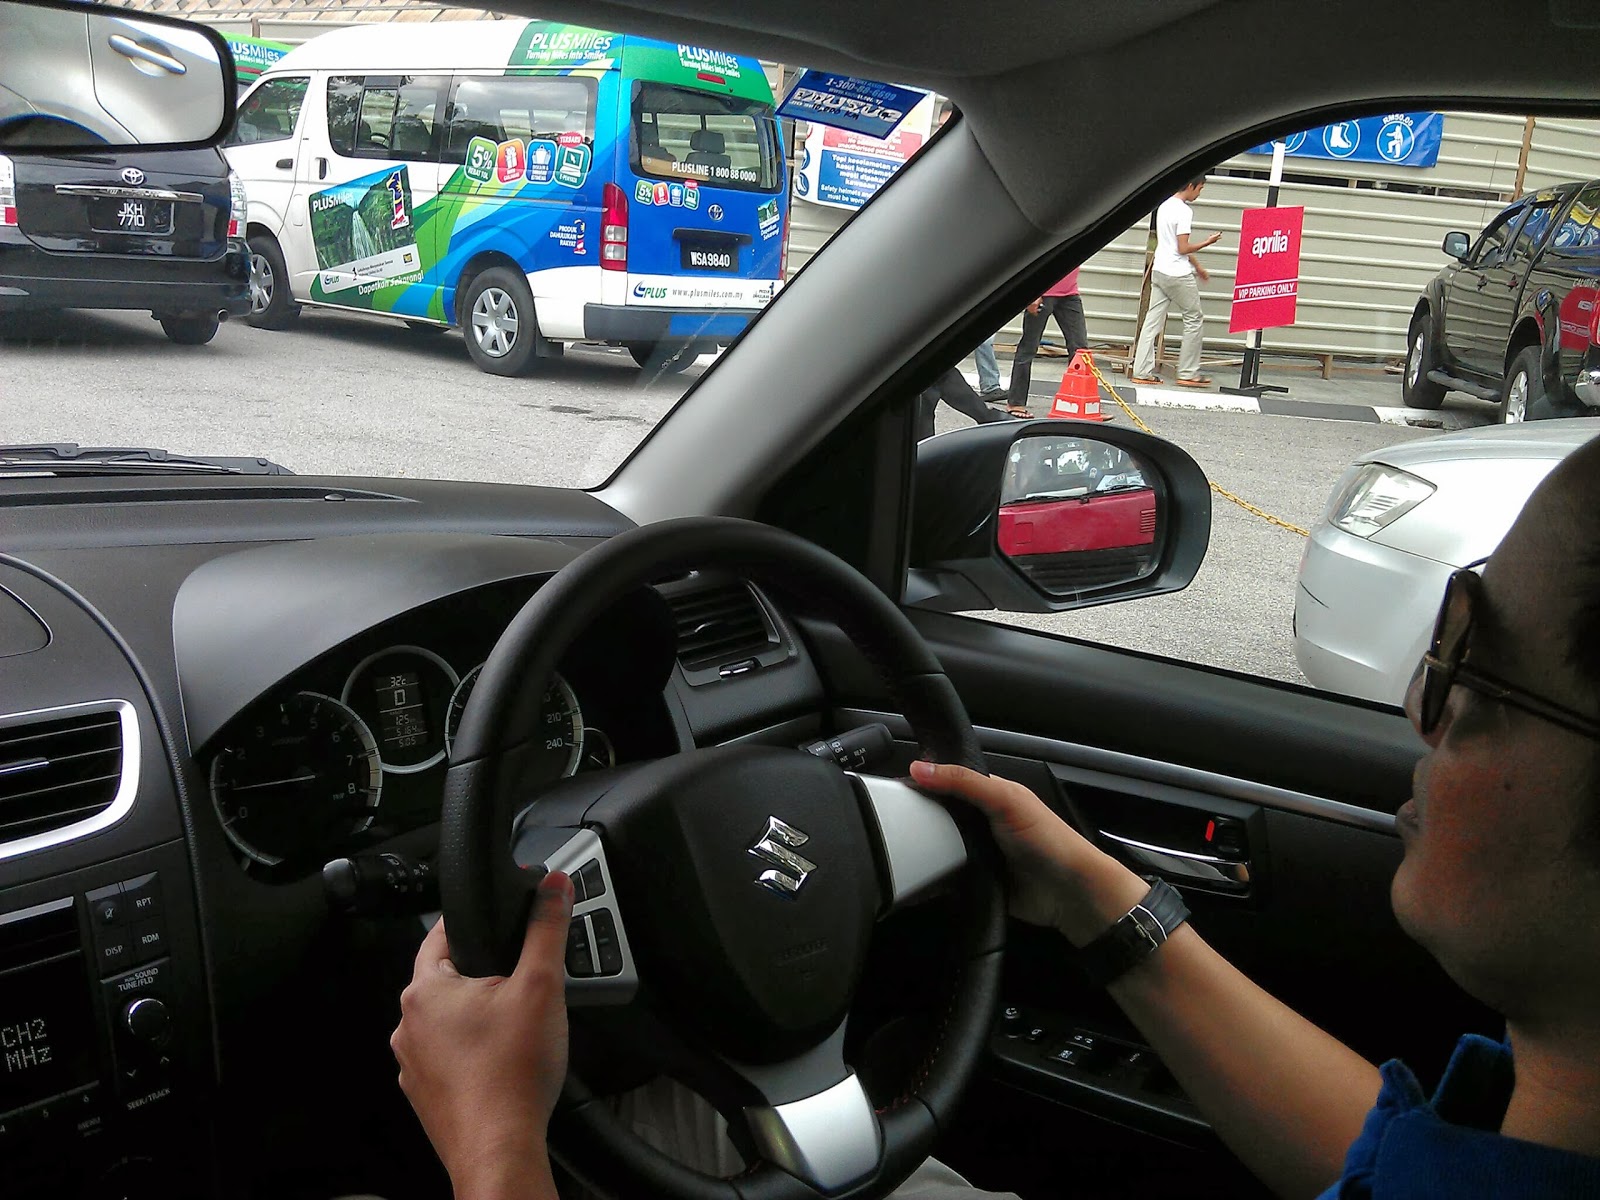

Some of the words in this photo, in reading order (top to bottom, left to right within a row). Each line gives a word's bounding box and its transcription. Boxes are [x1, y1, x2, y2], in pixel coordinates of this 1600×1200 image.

[528, 32, 613, 50] PLUSMiles
[677, 44, 739, 69] PLUSMiles
[1382, 113, 1414, 127] RM50.00
[471, 145, 493, 169] 5%
[832, 154, 847, 163] Topi
[847, 156, 891, 171] keselamatan
[672, 161, 709, 176] PLUSLINE
[710, 166, 714, 176] 1
[715, 168, 730, 179] 800
[730, 169, 740, 179] 88
[740, 171, 757, 182] 0000
[821, 184, 838, 193] Safety
[838, 187, 861, 196] helmets
[119, 203, 143, 215] JKH
[117, 213, 145, 226] 7710
[1252, 229, 1288, 259] aprilia
[690, 251, 730, 268] WSA9840
[358, 279, 390, 296] Dapatkan
[389, 269, 424, 287] Sekarang!
[643, 287, 668, 299] PLUS
[672, 288, 743, 300] www.plusmiles.com.my
[1239, 288, 1249, 299] VIP
[1249, 284, 1276, 298] PARKING
[1277, 282, 1295, 294] ONLY
[309, 717, 318, 729] 5
[547, 711, 562, 724] 210
[331, 731, 341, 743] 6
[546, 737, 563, 750] 240
[347, 754, 354, 767] 7
[347, 782, 357, 795] 8
[238, 806, 249, 819] 0
[136, 897, 152, 908] RPT
[141, 933, 160, 945] RDM
[105, 945, 124, 957] DISP
[135, 967, 159, 980] SOUND
[118, 976, 154, 992] TUNE/FLD
[1, 1018, 47, 1049] CH2
[83, 1094, 90, 1103] 6
[127, 1088, 171, 1111] SEEK/TRACK
